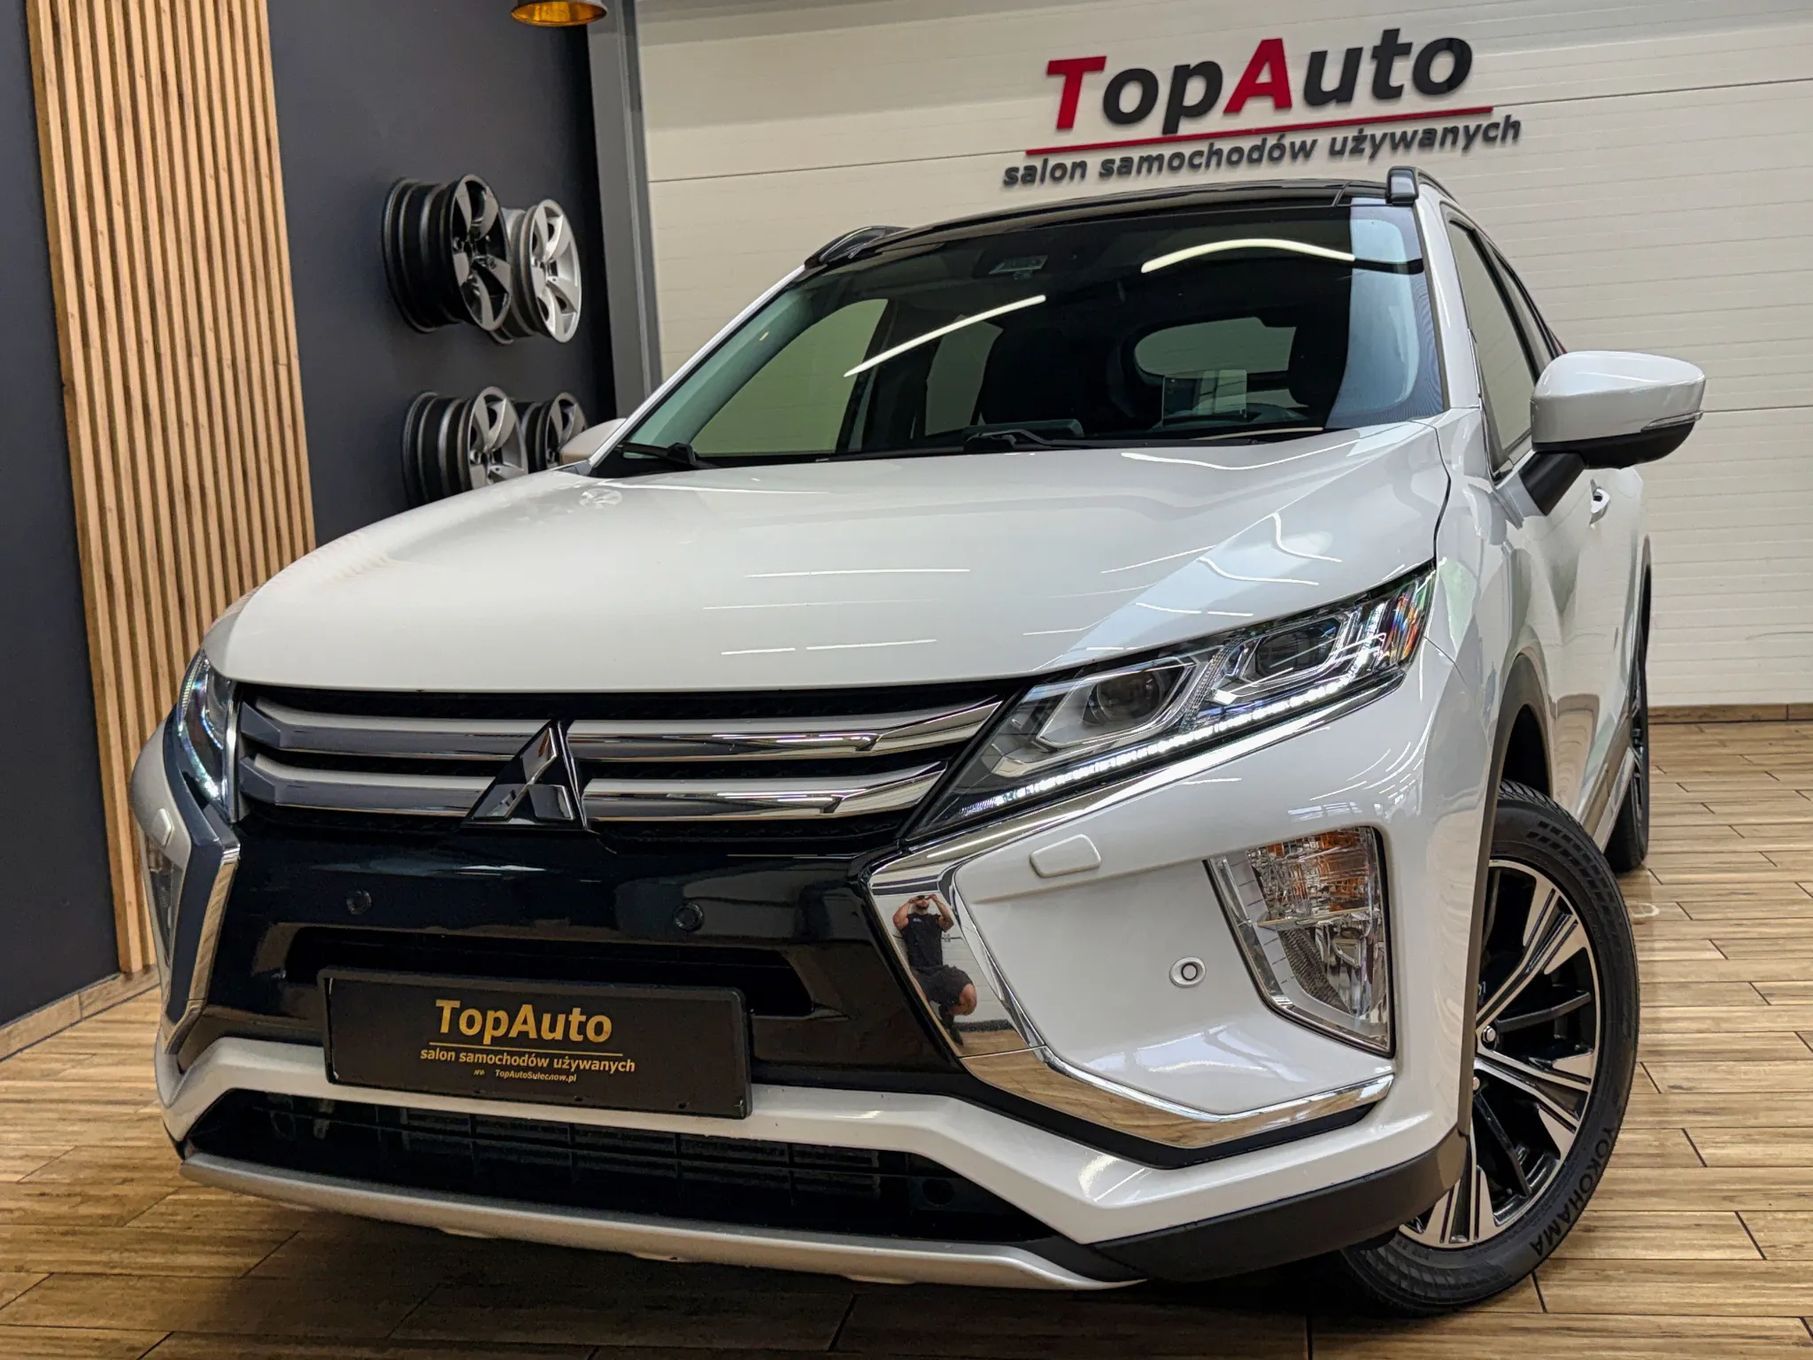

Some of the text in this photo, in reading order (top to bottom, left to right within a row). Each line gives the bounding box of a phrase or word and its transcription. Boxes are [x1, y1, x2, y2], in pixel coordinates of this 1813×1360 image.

[1046, 27, 1474, 135] TopAuto
[1003, 114, 1522, 188] salon samochodów używanych
[435, 999, 613, 1045] TopAuto
[420, 1048, 636, 1074] salon samochodów używanych
[1529, 1127, 1616, 1257] YOKOHAMA
